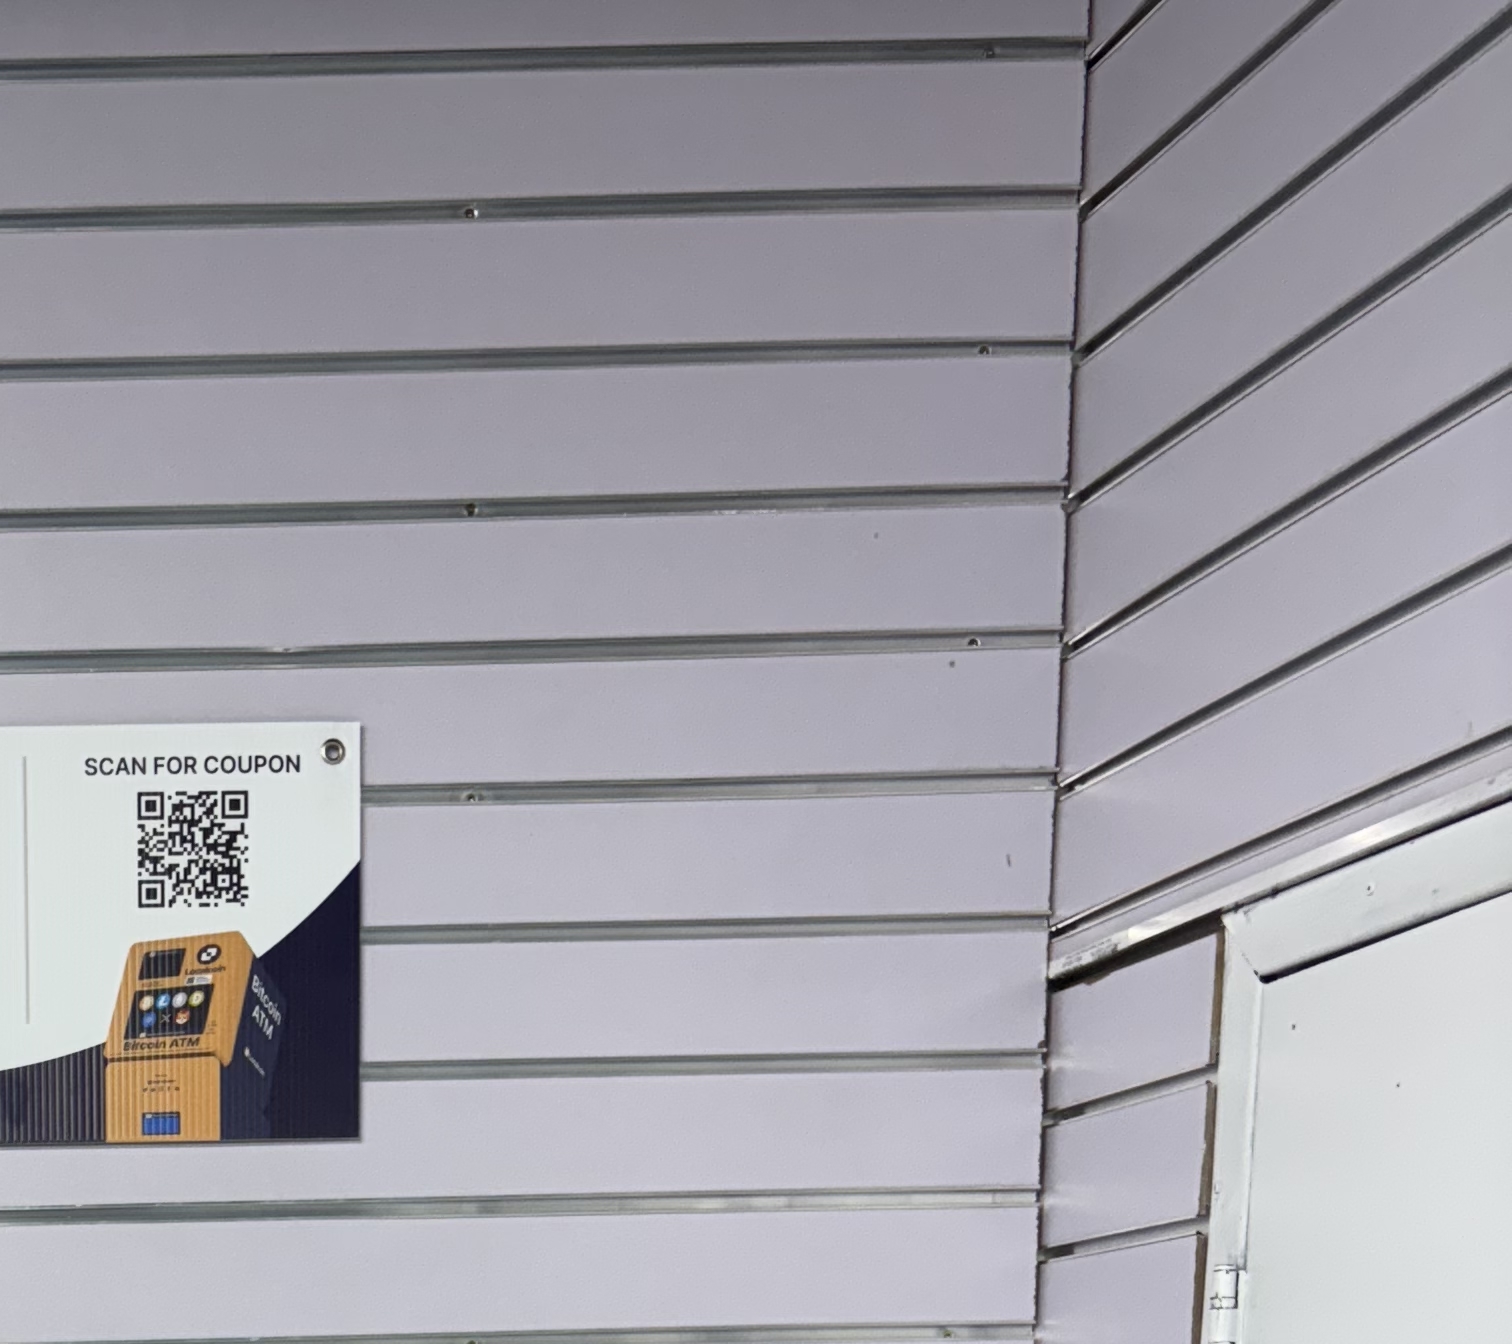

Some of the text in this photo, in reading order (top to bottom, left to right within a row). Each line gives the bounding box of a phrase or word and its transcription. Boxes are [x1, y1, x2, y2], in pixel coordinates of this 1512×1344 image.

[84, 754, 301, 776] SCAN FOR COUPON
[251, 973, 282, 1026] Bitcoin
[251, 1004, 275, 1041] ATM
[169, 1037, 201, 1048] ATM
